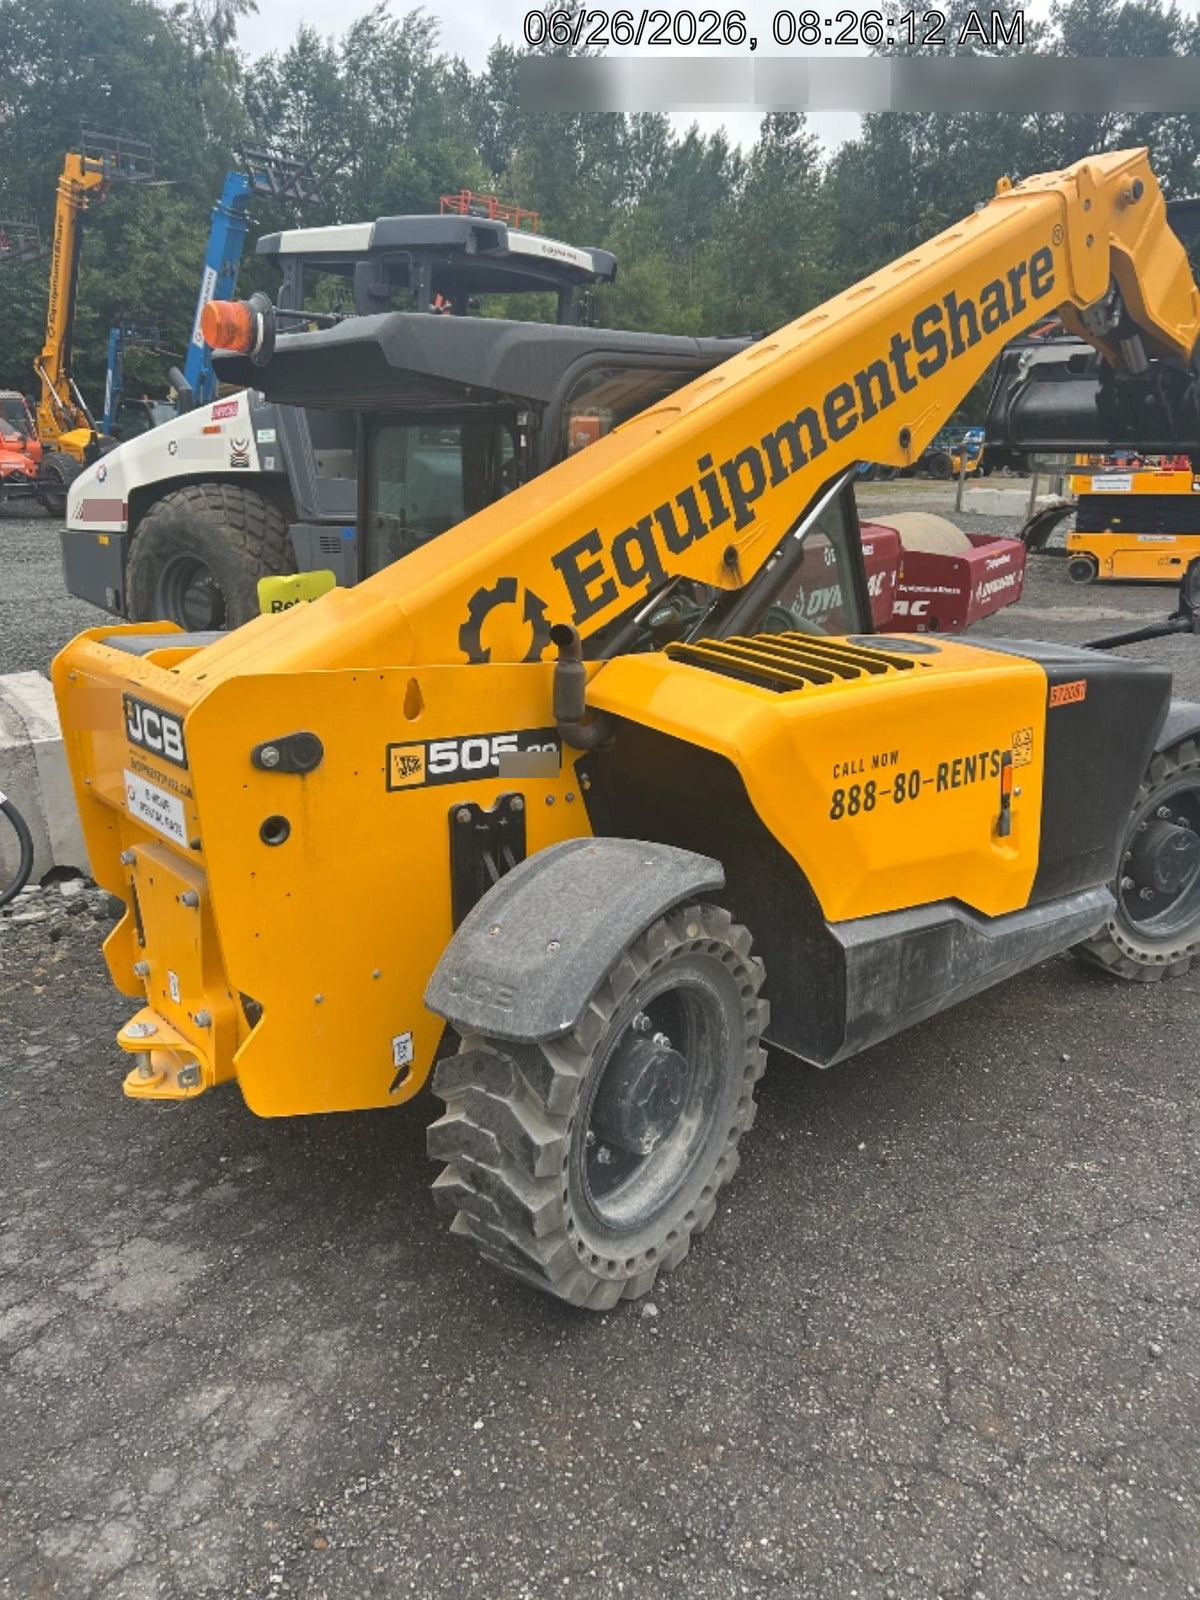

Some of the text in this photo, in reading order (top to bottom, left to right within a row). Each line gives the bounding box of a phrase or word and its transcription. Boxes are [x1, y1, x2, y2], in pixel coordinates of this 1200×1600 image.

[551, 244, 1056, 627] EquipmentShare
[128, 704, 184, 762] JCB
[833, 750, 900, 780] CALL NOW
[829, 748, 1001, 821] 888-80-RENTS
